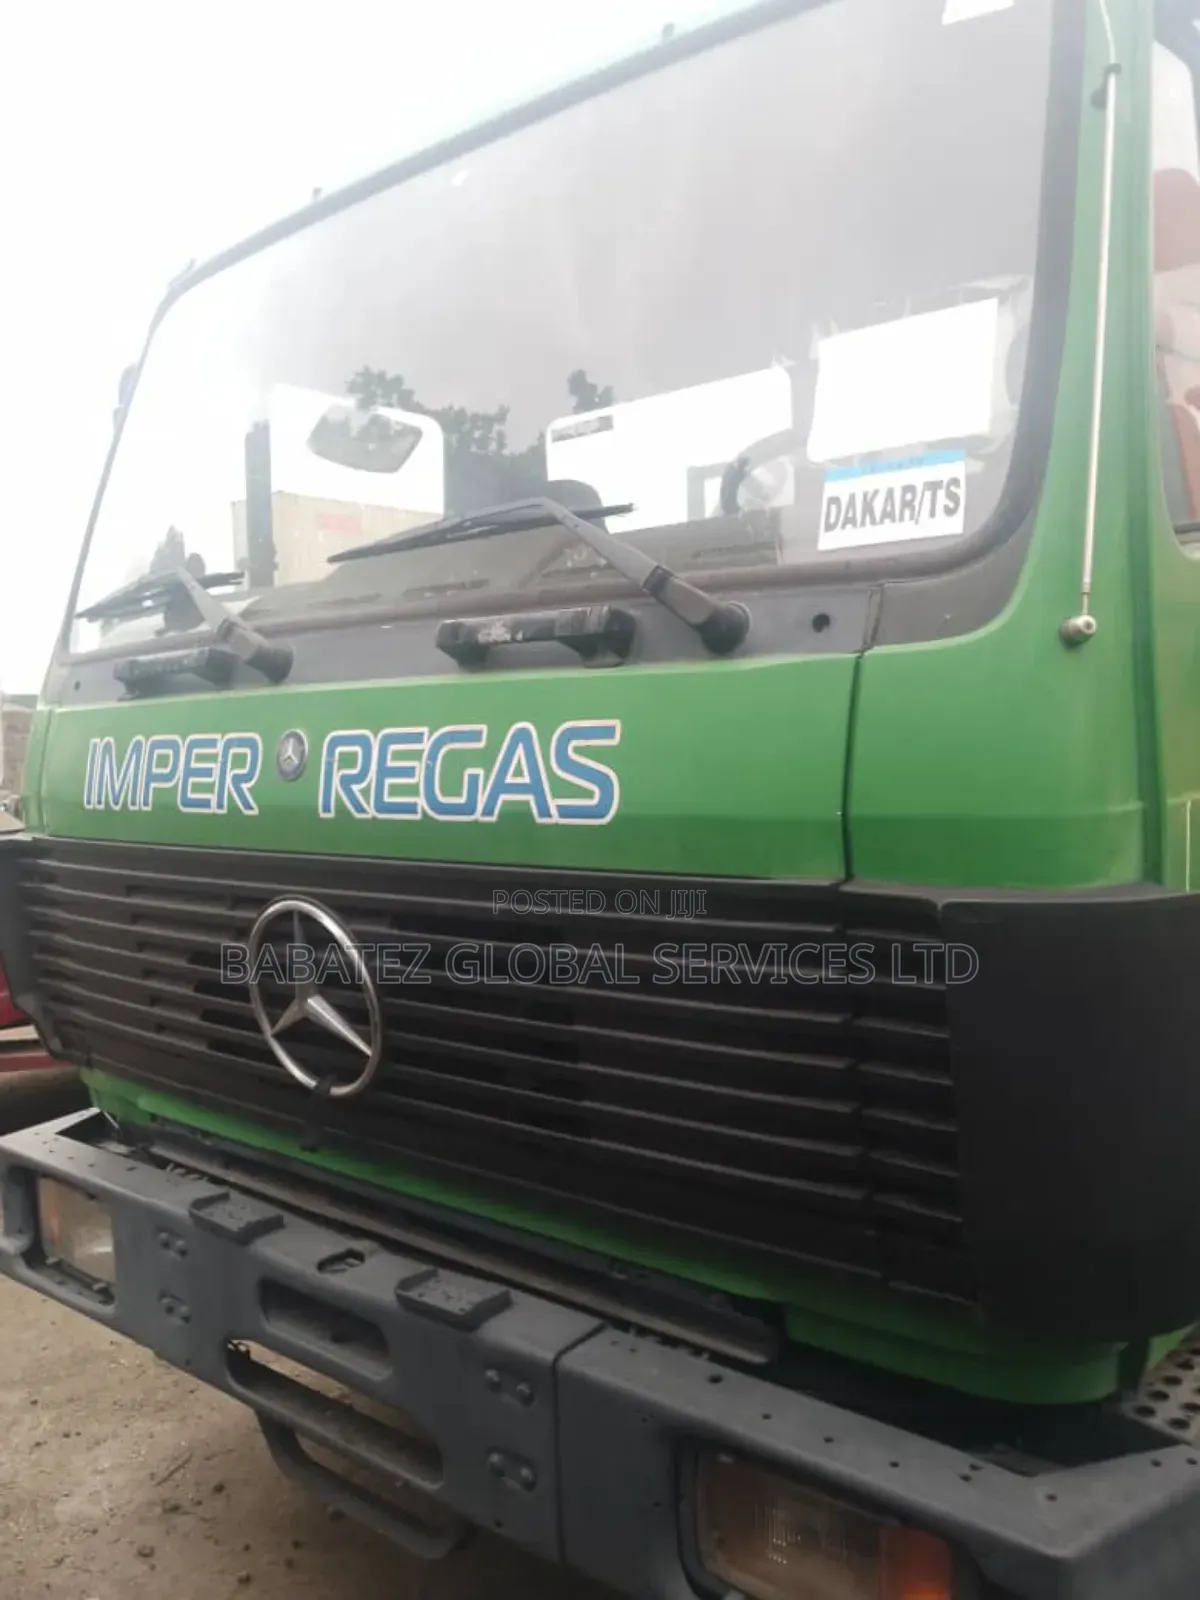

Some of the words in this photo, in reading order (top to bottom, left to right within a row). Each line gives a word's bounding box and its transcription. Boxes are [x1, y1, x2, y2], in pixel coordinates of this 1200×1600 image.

[824, 476, 962, 534] DAKAR/TS
[84, 732, 262, 815] IMPER
[319, 720, 621, 825] REGAS
